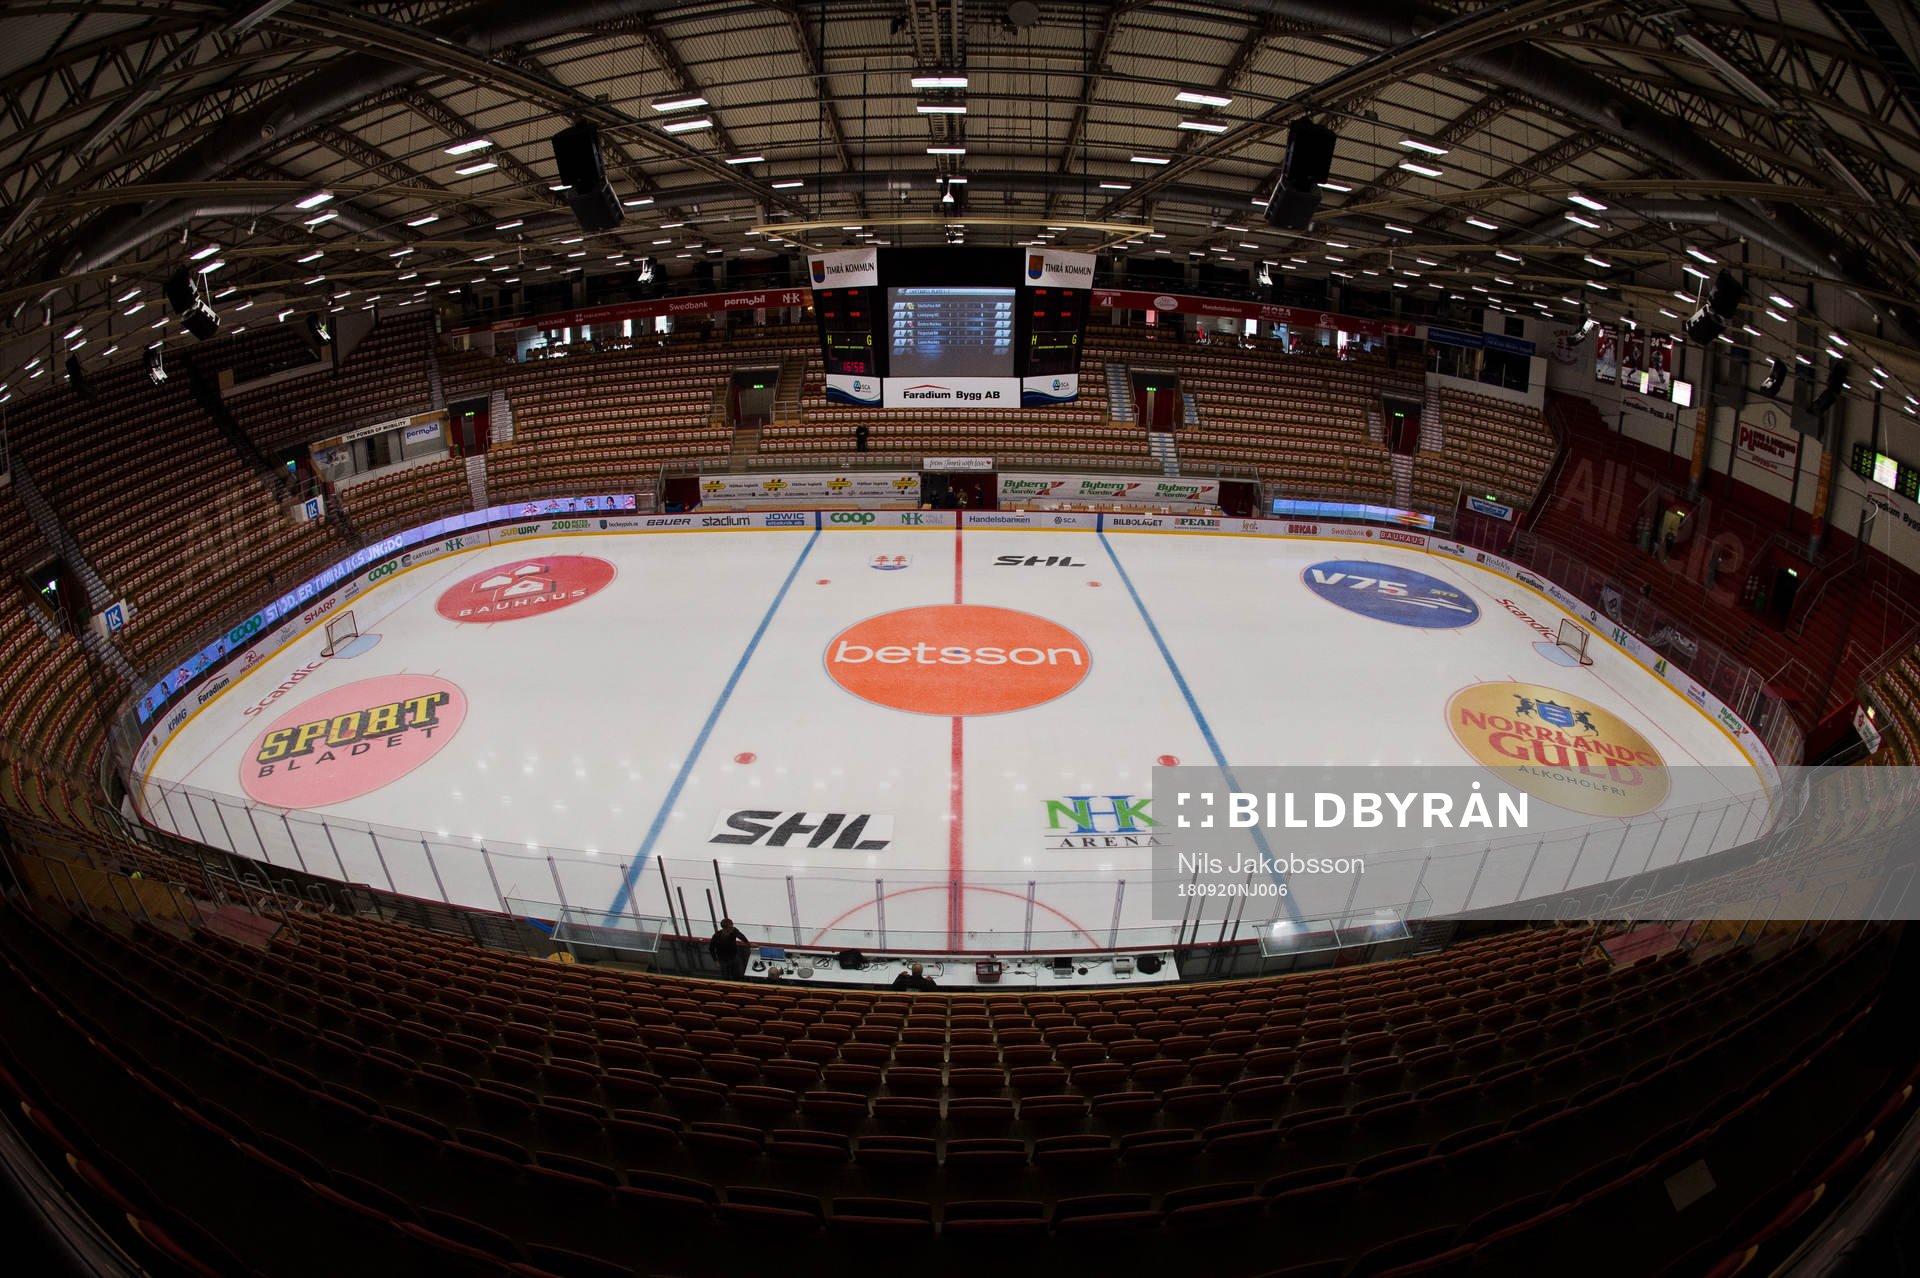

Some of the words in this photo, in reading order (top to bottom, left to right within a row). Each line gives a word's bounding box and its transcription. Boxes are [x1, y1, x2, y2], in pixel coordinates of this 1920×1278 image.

[826, 263, 844, 275] TIMRÅ
[845, 262, 875, 273] KOMMUN
[1045, 262, 1064, 274] TIMRÅ
[1065, 264, 1092, 276] KOMMUN
[669, 301, 708, 312] Swedbank
[724, 295, 766, 308] permobil
[903, 391, 951, 399] Faradium
[956, 391, 982, 400] Bygg
[985, 391, 1001, 399] AB
[356, 429, 374, 438] POWER
[406, 424, 439, 440] permobil
[1004, 480, 1048, 489] Byberg
[1081, 480, 1125, 490] Byberg
[1157, 483, 1199, 493] Byberg
[702, 516, 750, 526] stadium
[830, 512, 876, 525] coop
[1181, 518, 1216, 527] PEAB
[500, 524, 541, 537] SUBWAY
[1331, 527, 1365, 537] Swedbank
[1380, 531, 1425, 545] BAUHAUS
[412, 546, 440, 560] CASTELLUM
[994, 555, 1086, 567] SHL
[367, 560, 398, 582] coop
[1312, 569, 1408, 596] V75
[1516, 572, 1544, 591] Faradium
[459, 588, 588, 617] BAUHAUS
[304, 598, 336, 625] SHARP
[1501, 598, 1559, 640] Scandic
[230, 615, 262, 643] coop
[834, 640, 1083, 666] betsson
[197, 677, 230, 704] Faradium
[244, 661, 321, 718] Scandic
[167, 708, 188, 734] KPMG
[256, 691, 449, 764] SPORT
[1460, 707, 1659, 771] NORRLANDS
[257, 725, 440, 779] BLADET
[1488, 731, 1644, 787] GULD
[1518, 764, 1627, 797] ALKOHOLFRI
[1045, 795, 1164, 834] NHK
[708, 809, 893, 850] SHL
[1058, 836, 1161, 848] ARENA
